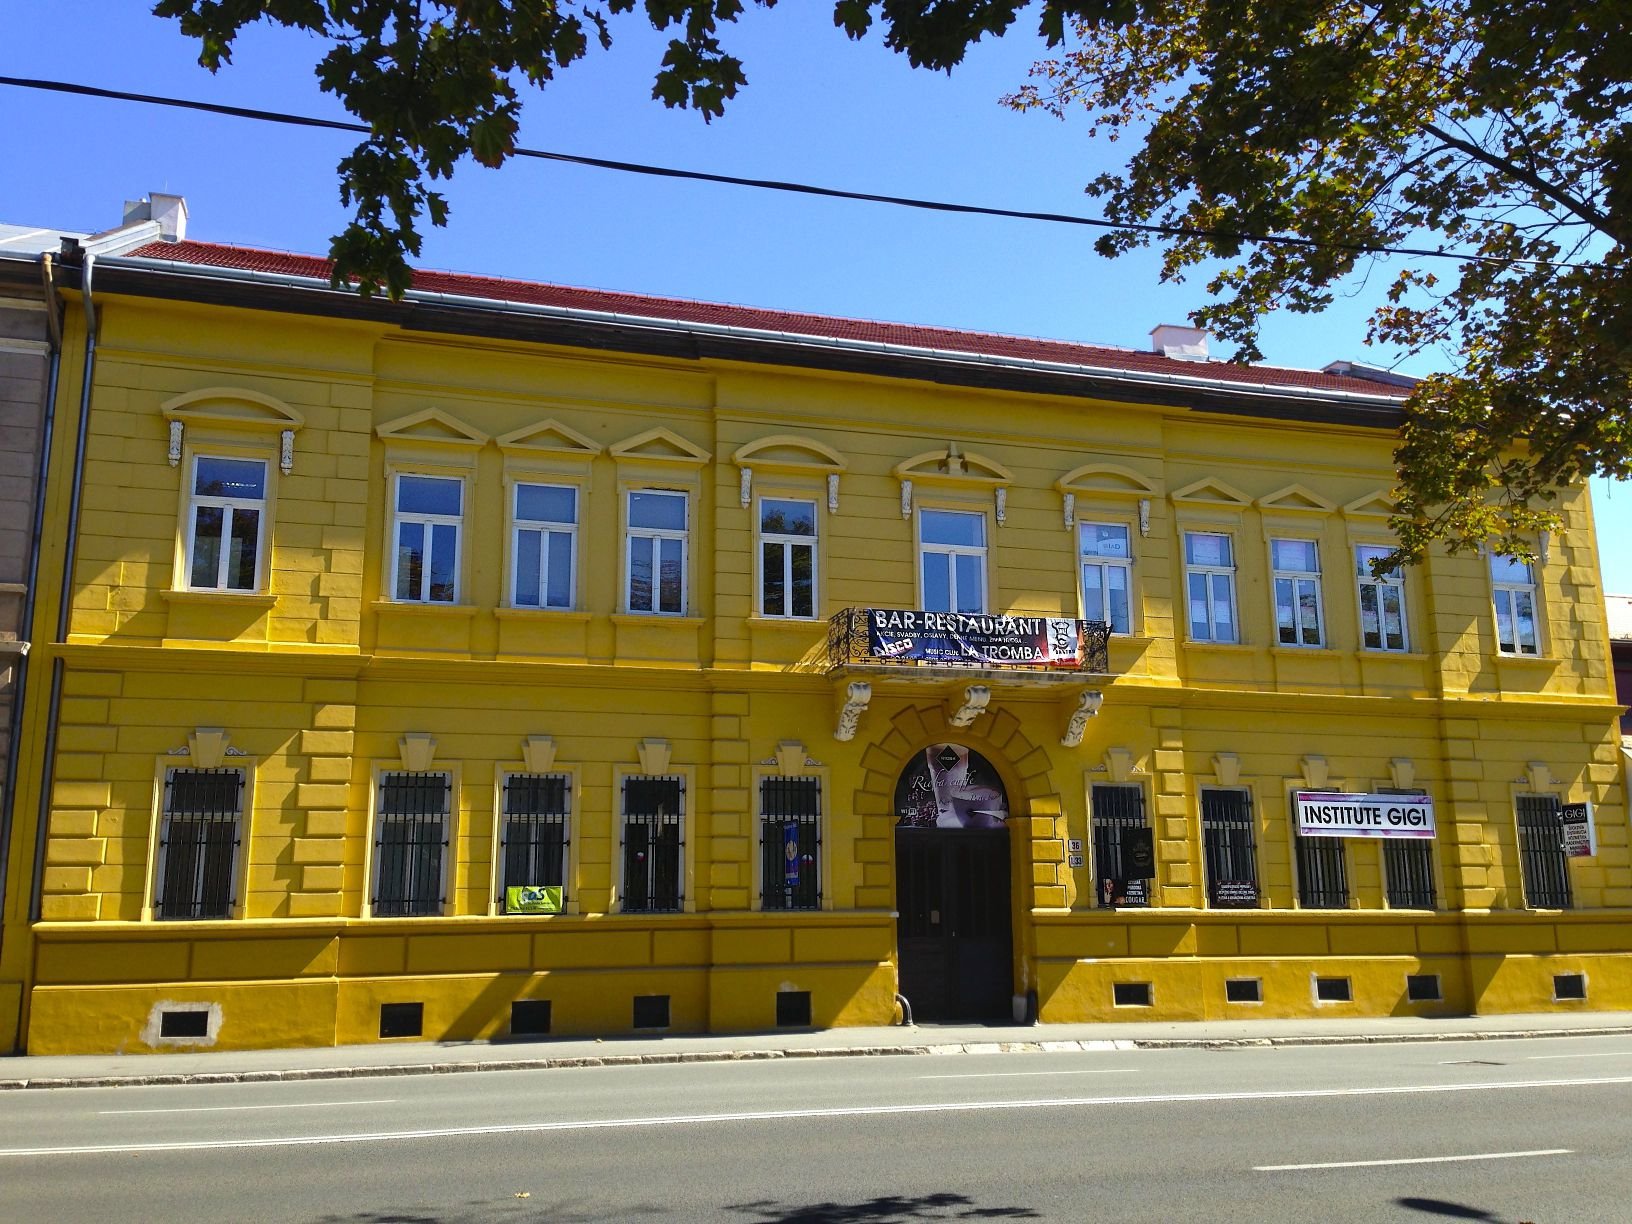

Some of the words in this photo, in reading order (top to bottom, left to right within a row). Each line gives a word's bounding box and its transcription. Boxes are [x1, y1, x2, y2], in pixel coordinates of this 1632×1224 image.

[875, 610, 1041, 636] BAR-RESTAURANT
[981, 645, 1046, 660] TROMBA
[1304, 805, 1382, 825] INSTITUTE
[1387, 807, 1427, 826] GIGI
[1564, 808, 1586, 818] GIGI
[1071, 841, 1080, 850] 36
